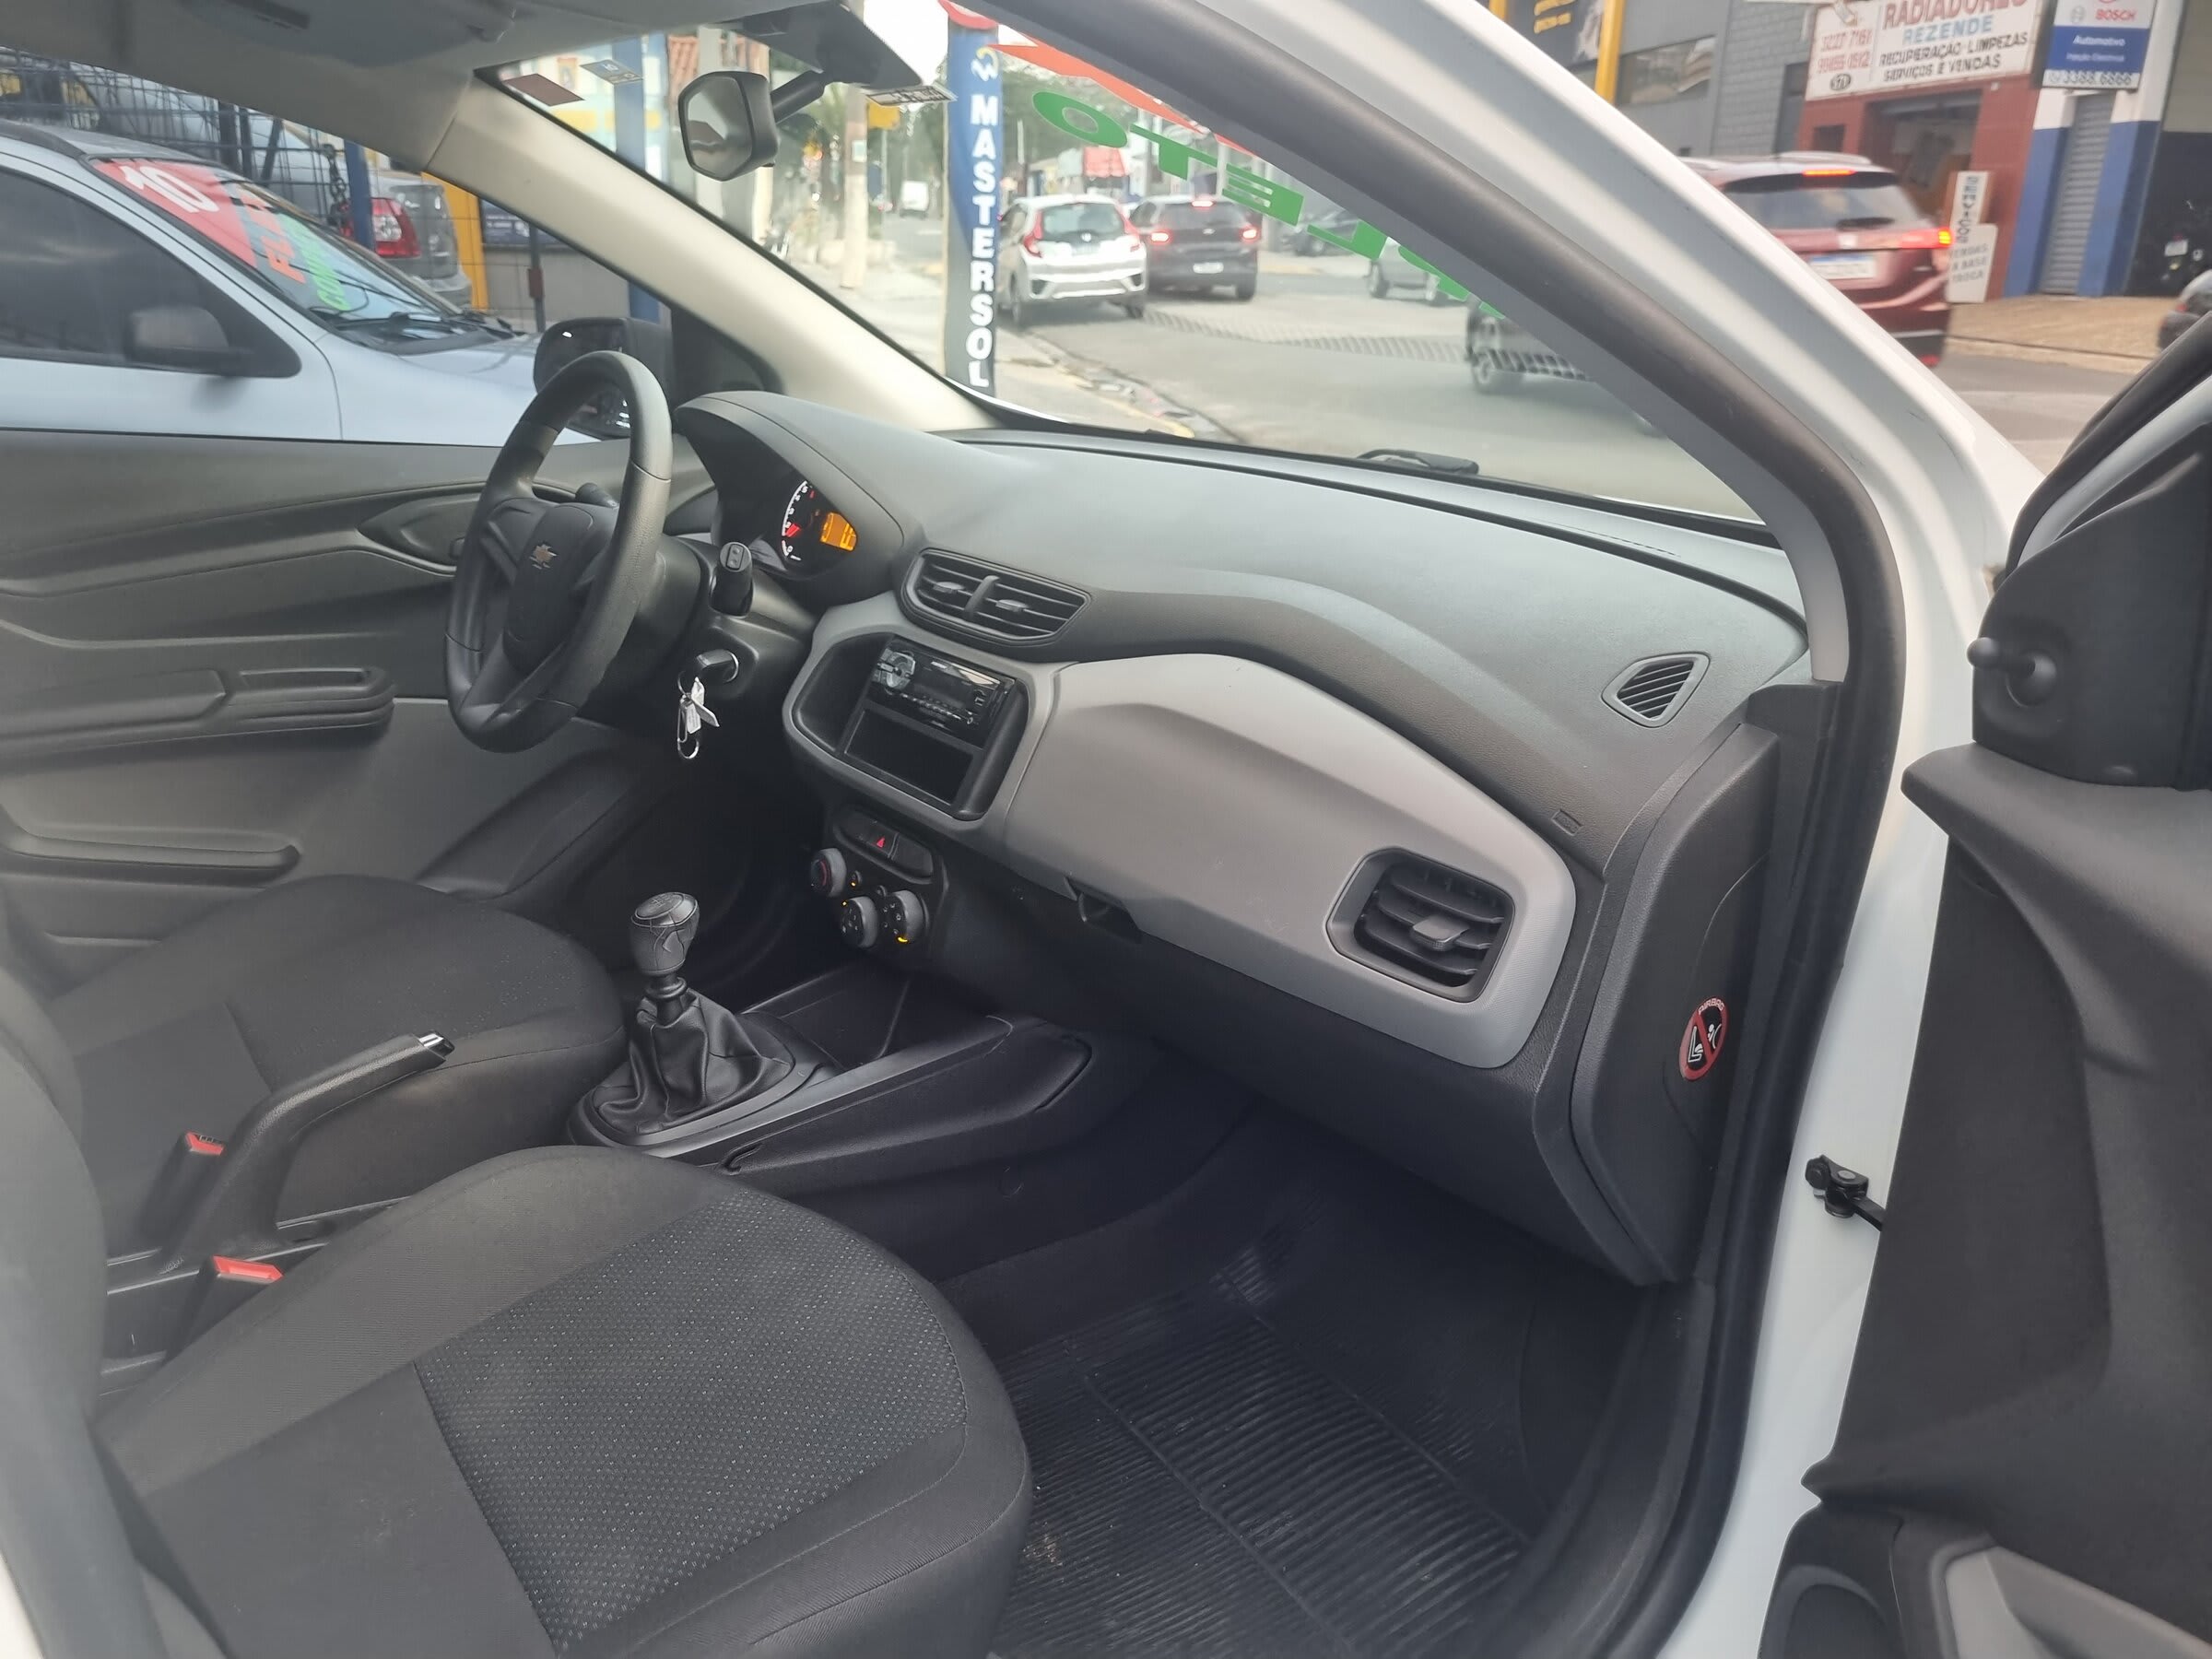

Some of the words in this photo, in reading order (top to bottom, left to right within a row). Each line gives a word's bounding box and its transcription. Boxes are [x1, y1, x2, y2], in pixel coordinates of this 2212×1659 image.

[1883, 0, 2025, 29] RADIADO
[2095, 8, 2136, 21] BOSCH
[1902, 14, 1994, 45] REZENDE
[1948, 53, 2002, 73] VENDAS
[119, 165, 219, 213] 10
[965, 94, 998, 388] MASTERSOL
[1698, 997, 1724, 1016] AIRBAG
